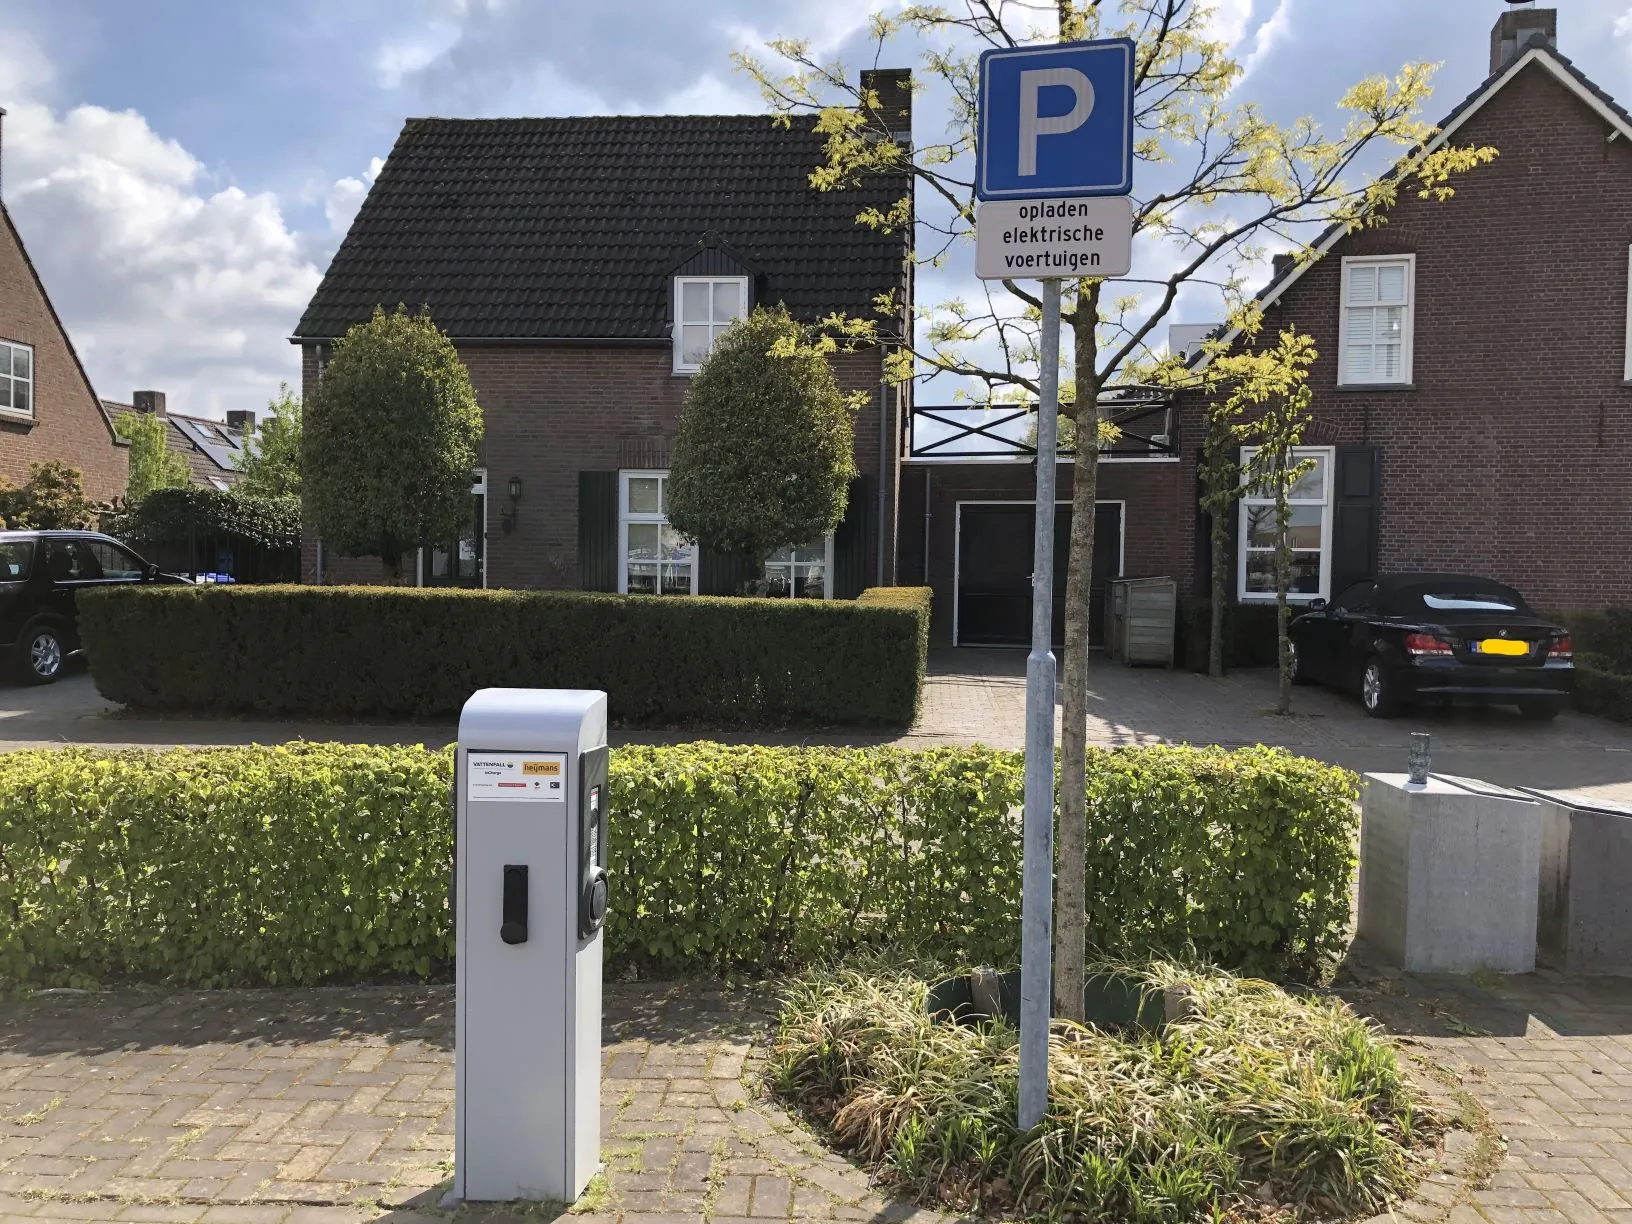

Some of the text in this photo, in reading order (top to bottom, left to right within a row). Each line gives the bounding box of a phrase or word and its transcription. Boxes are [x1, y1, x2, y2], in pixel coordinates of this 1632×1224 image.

[1018, 67, 1095, 176] P
[1019, 201, 1088, 221] opladen
[1003, 225, 1104, 244] elektrische
[1005, 251, 1100, 271] voertuigen
